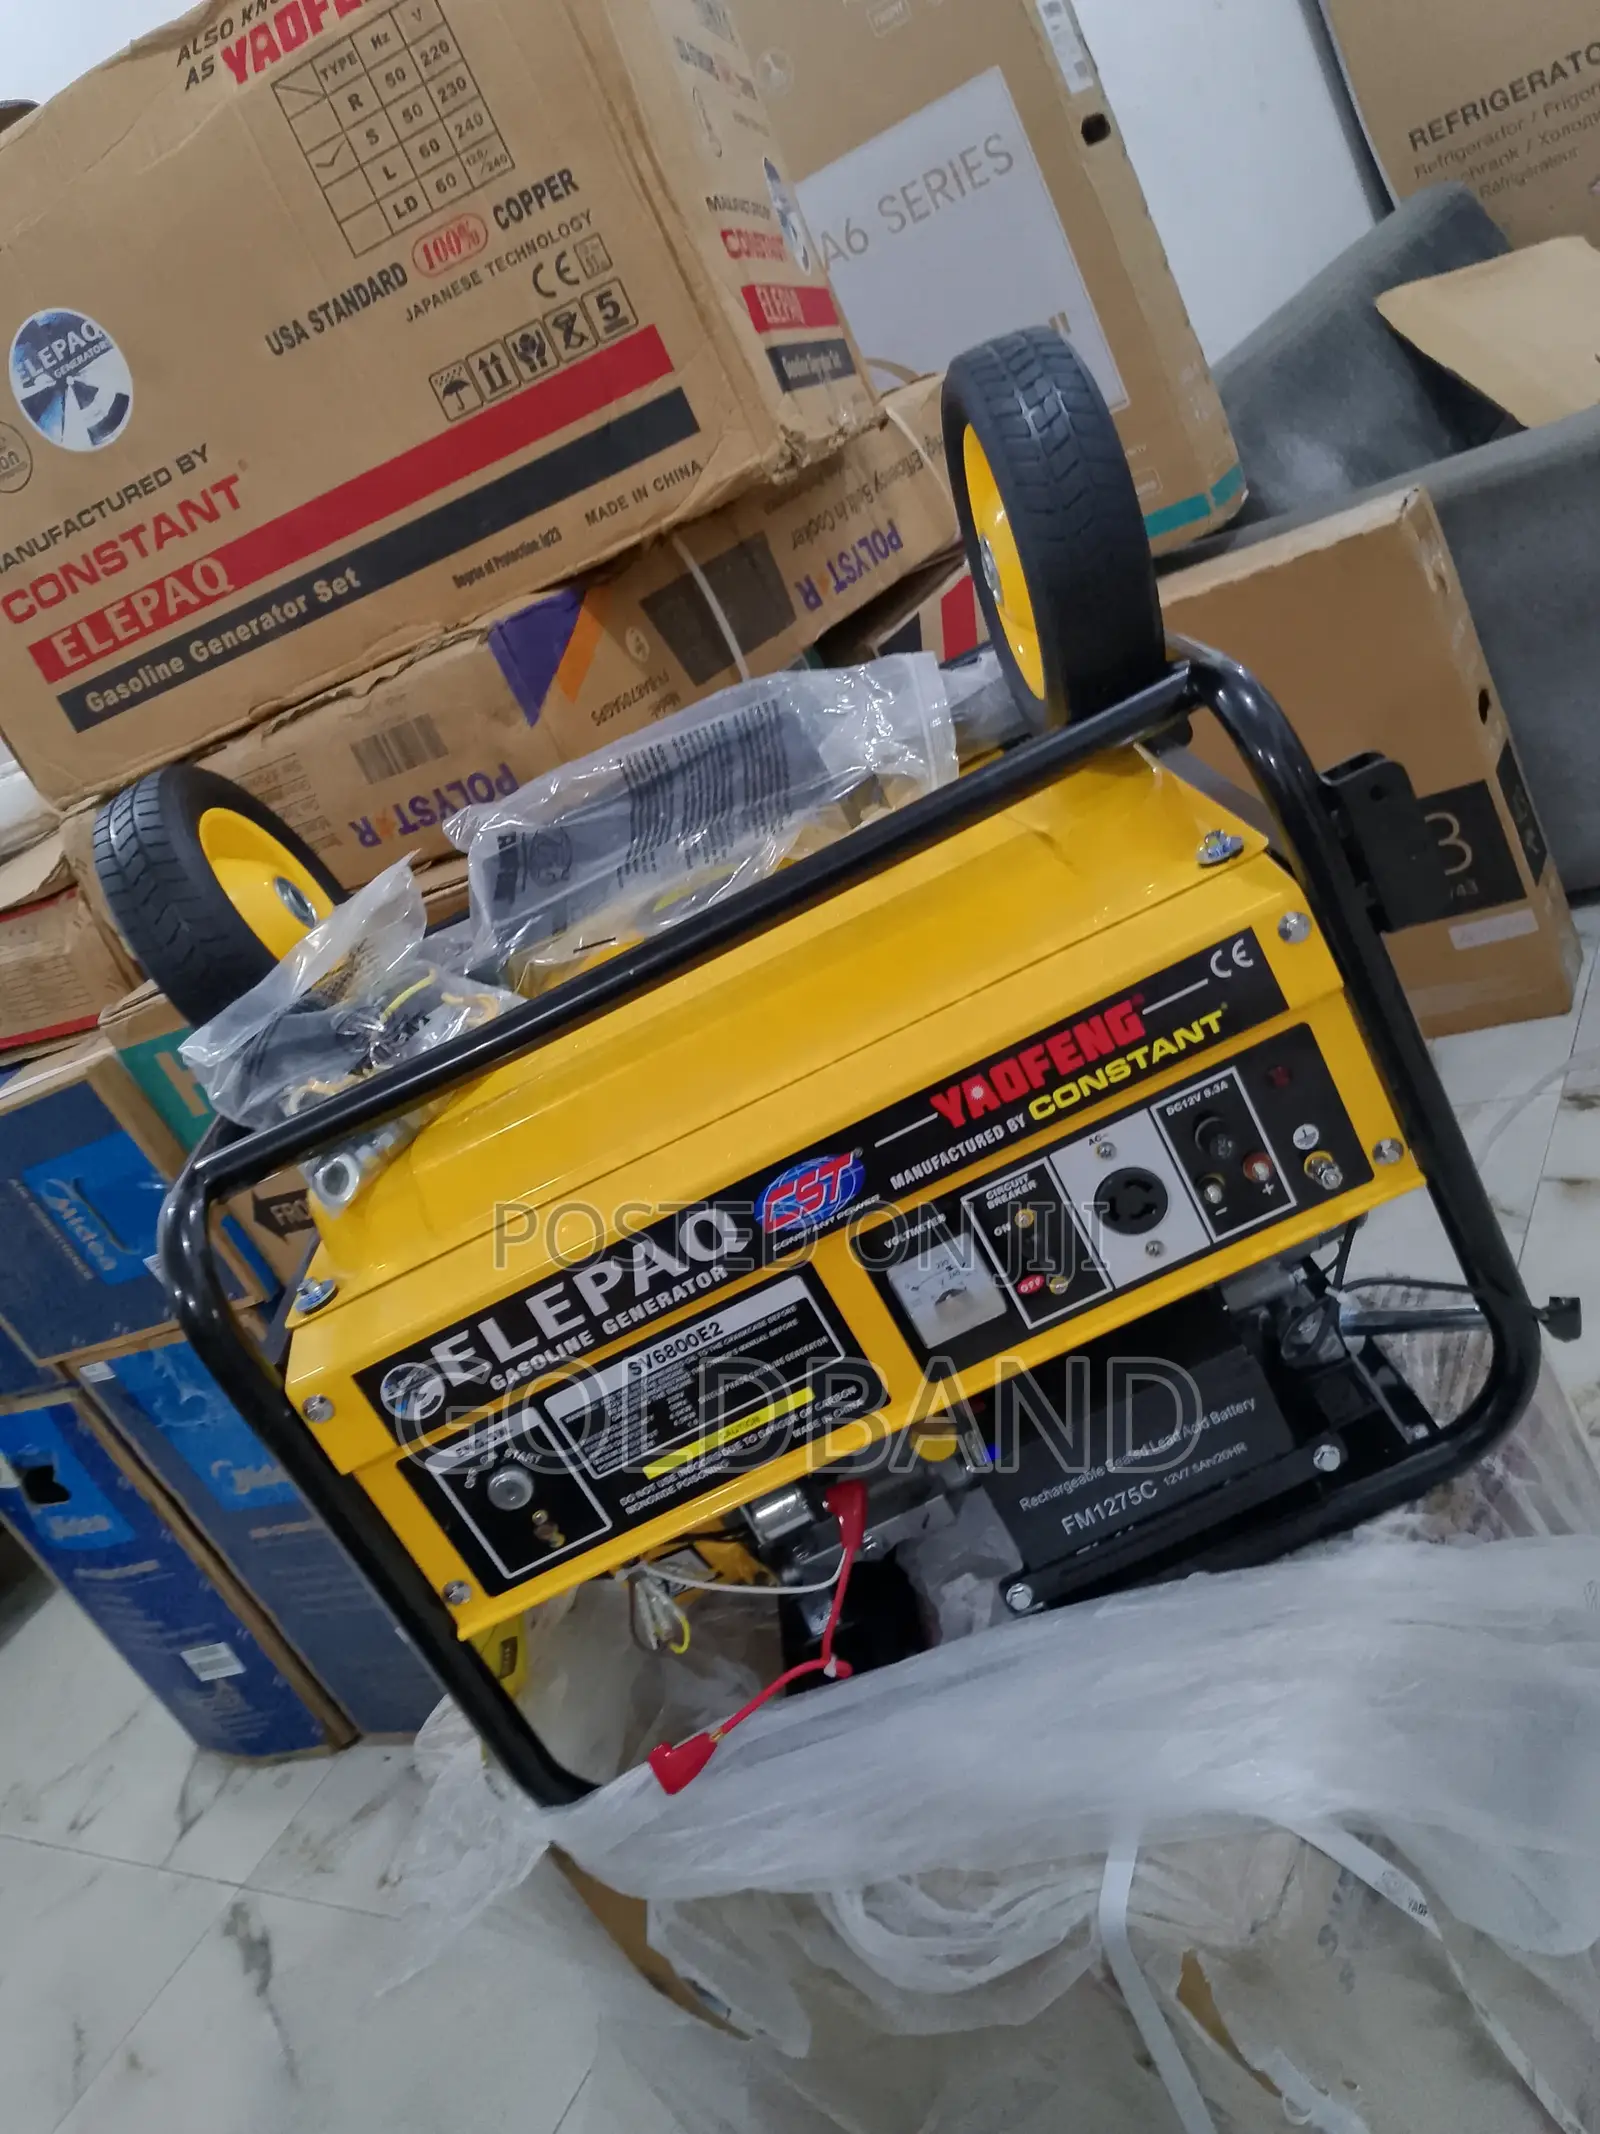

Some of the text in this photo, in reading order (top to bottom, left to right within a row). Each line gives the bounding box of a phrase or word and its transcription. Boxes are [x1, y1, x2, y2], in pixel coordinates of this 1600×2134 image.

[177, 0, 279, 67] ALSO KN
[320, 50, 358, 82] TYPE
[370, 32, 391, 51] Hz
[185, 54, 215, 91] AS
[348, 40, 449, 111] R 50 220
[366, 128, 380, 146] S
[437, 77, 466, 103] 230
[383, 166, 397, 181] L
[454, 111, 484, 138] 240
[393, 194, 418, 220] LD
[820, 133, 1014, 270] A6 SERIES
[265, 168, 580, 356] USA STANDARD 100% COPPER
[406, 269, 483, 323] JAPANESE
[484, 209, 593, 277] TECHNOLOGY
[18, 320, 104, 382] ELEPAQ
[0, 443, 211, 574] ANUFACTURED BY
[584, 460, 704, 527] MADE IN CHINA
[1, 475, 245, 624] CONSTANT
[51, 558, 235, 667] ELEPAQ
[85, 566, 362, 714] Gasoline Generator Set
[1425, 812, 1473, 876] 3
[1210, 938, 1254, 980] CE
[930, 998, 1147, 1130] YAOFENG
[890, 1007, 1226, 1191] MANUFACTURED BY CONSTANT
[1166, 1093, 1201, 1116] DC12V
[986, 1173, 1029, 1200] CIRCUIT
[987, 1179, 1037, 1210] BREAKER
[884, 1212, 947, 1250] VOLTMETER
[994, 1222, 1011, 1237] ON
[431, 1208, 749, 1388] ELEPAQ
[1020, 1277, 1042, 1293] OFF
[489, 1330, 595, 1391] GASOLINE
[602, 1264, 728, 1336] GENERATOR
[627, 1321, 724, 1377] SV6800E2
[827, 1396, 865, 1421] CHINA
[1019, 1467, 1105, 1511] Rechargeable
[1105, 1447, 1150, 1473] Sealed
[1149, 1431, 1183, 1453] Lead
[1211, 1397, 1256, 1427] Battery
[1061, 1480, 1159, 1535] FM1275C
